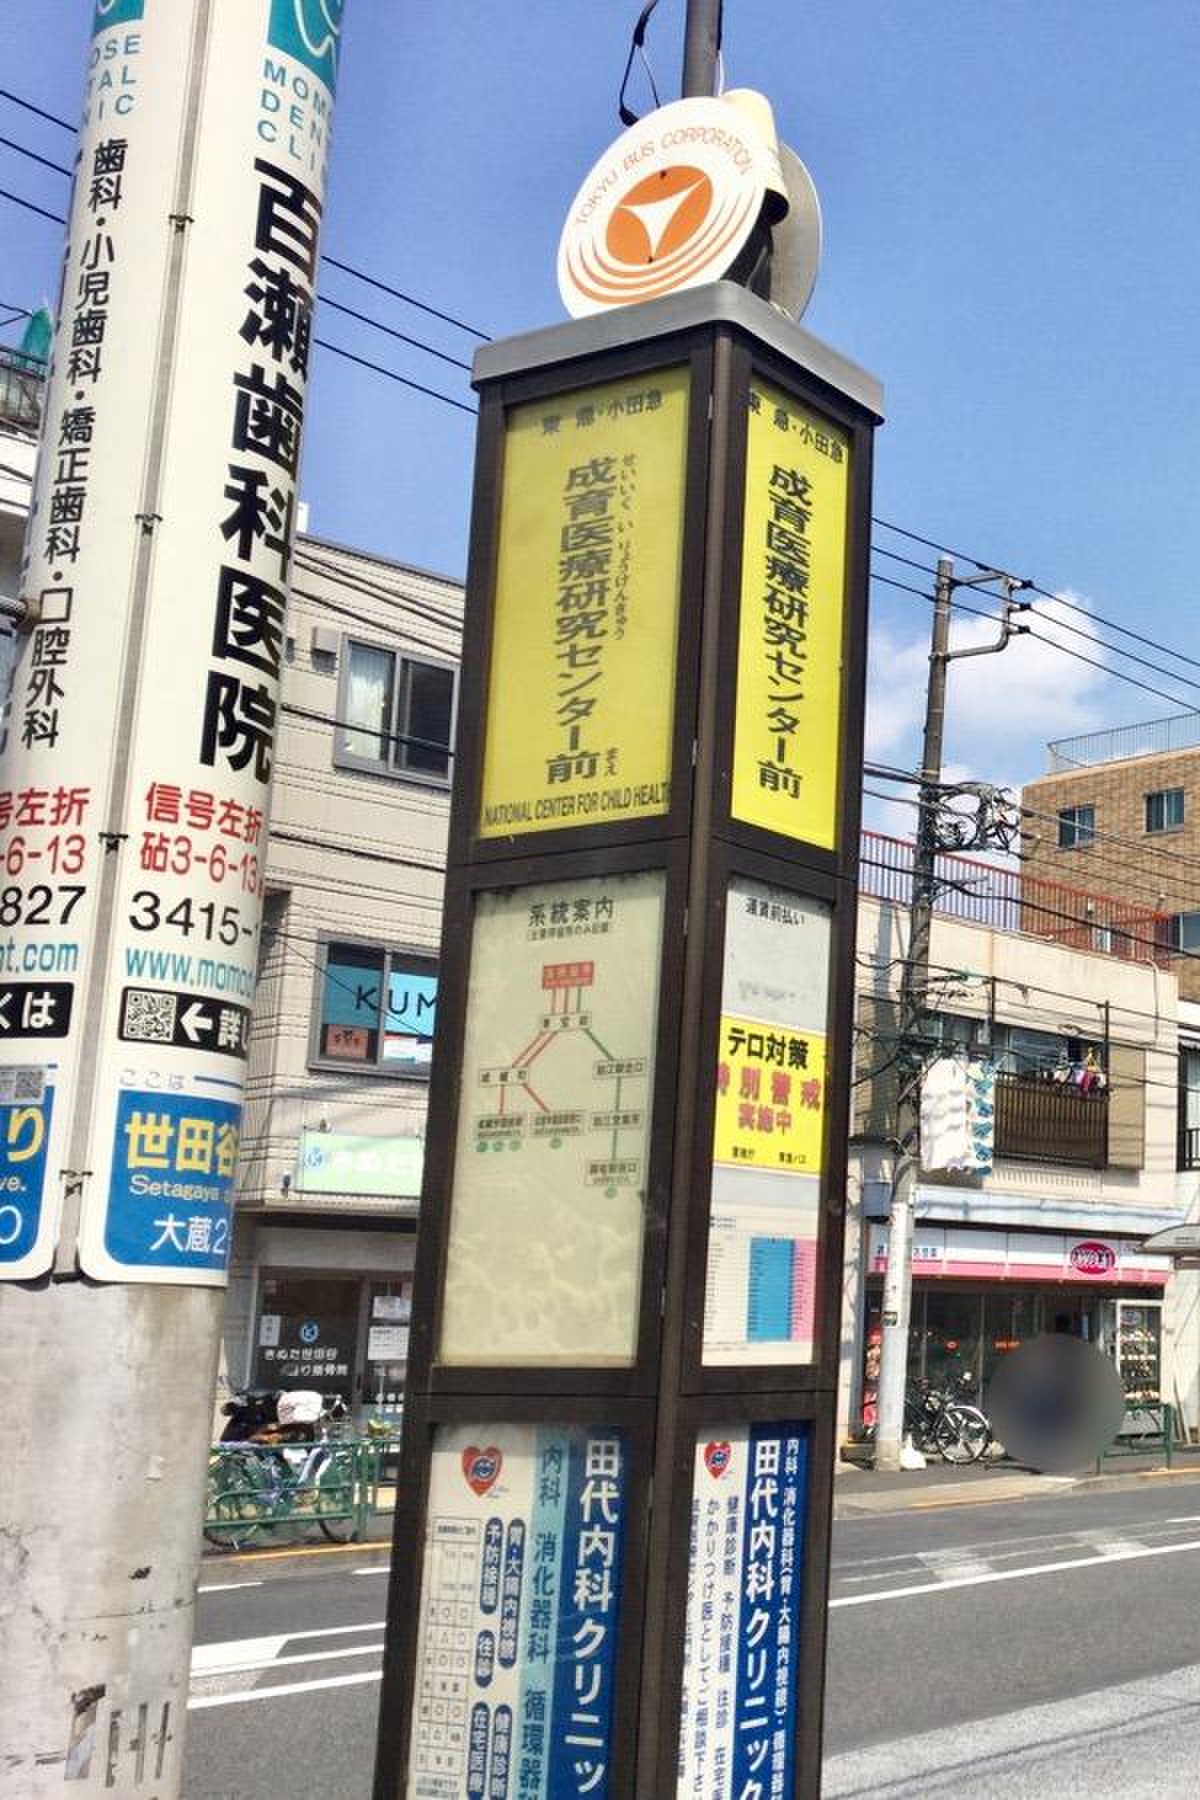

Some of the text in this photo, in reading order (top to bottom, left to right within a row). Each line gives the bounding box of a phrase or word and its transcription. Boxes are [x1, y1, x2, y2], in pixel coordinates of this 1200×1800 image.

[623, 141, 656, 172] BUS
[200, 157, 323, 785] 百瀬歯科医院
[546, 455, 617, 785] 成育医療研究センター前
[757, 464, 815, 800] 成育医療研究センター前
[535, 793, 576, 820] CENTER
[577, 790, 600, 815] FOR
[0, 885, 87, 927] 827
[129, 890, 259, 946] 3415-
[528, 896, 613, 927] 系統案内
[728, 1027, 809, 1070] テロ対策
[738, 1102, 792, 1136] 実施中
[124, 1111, 239, 1178] 世田谷
[517, 1689, 547, 1800] 循環器
